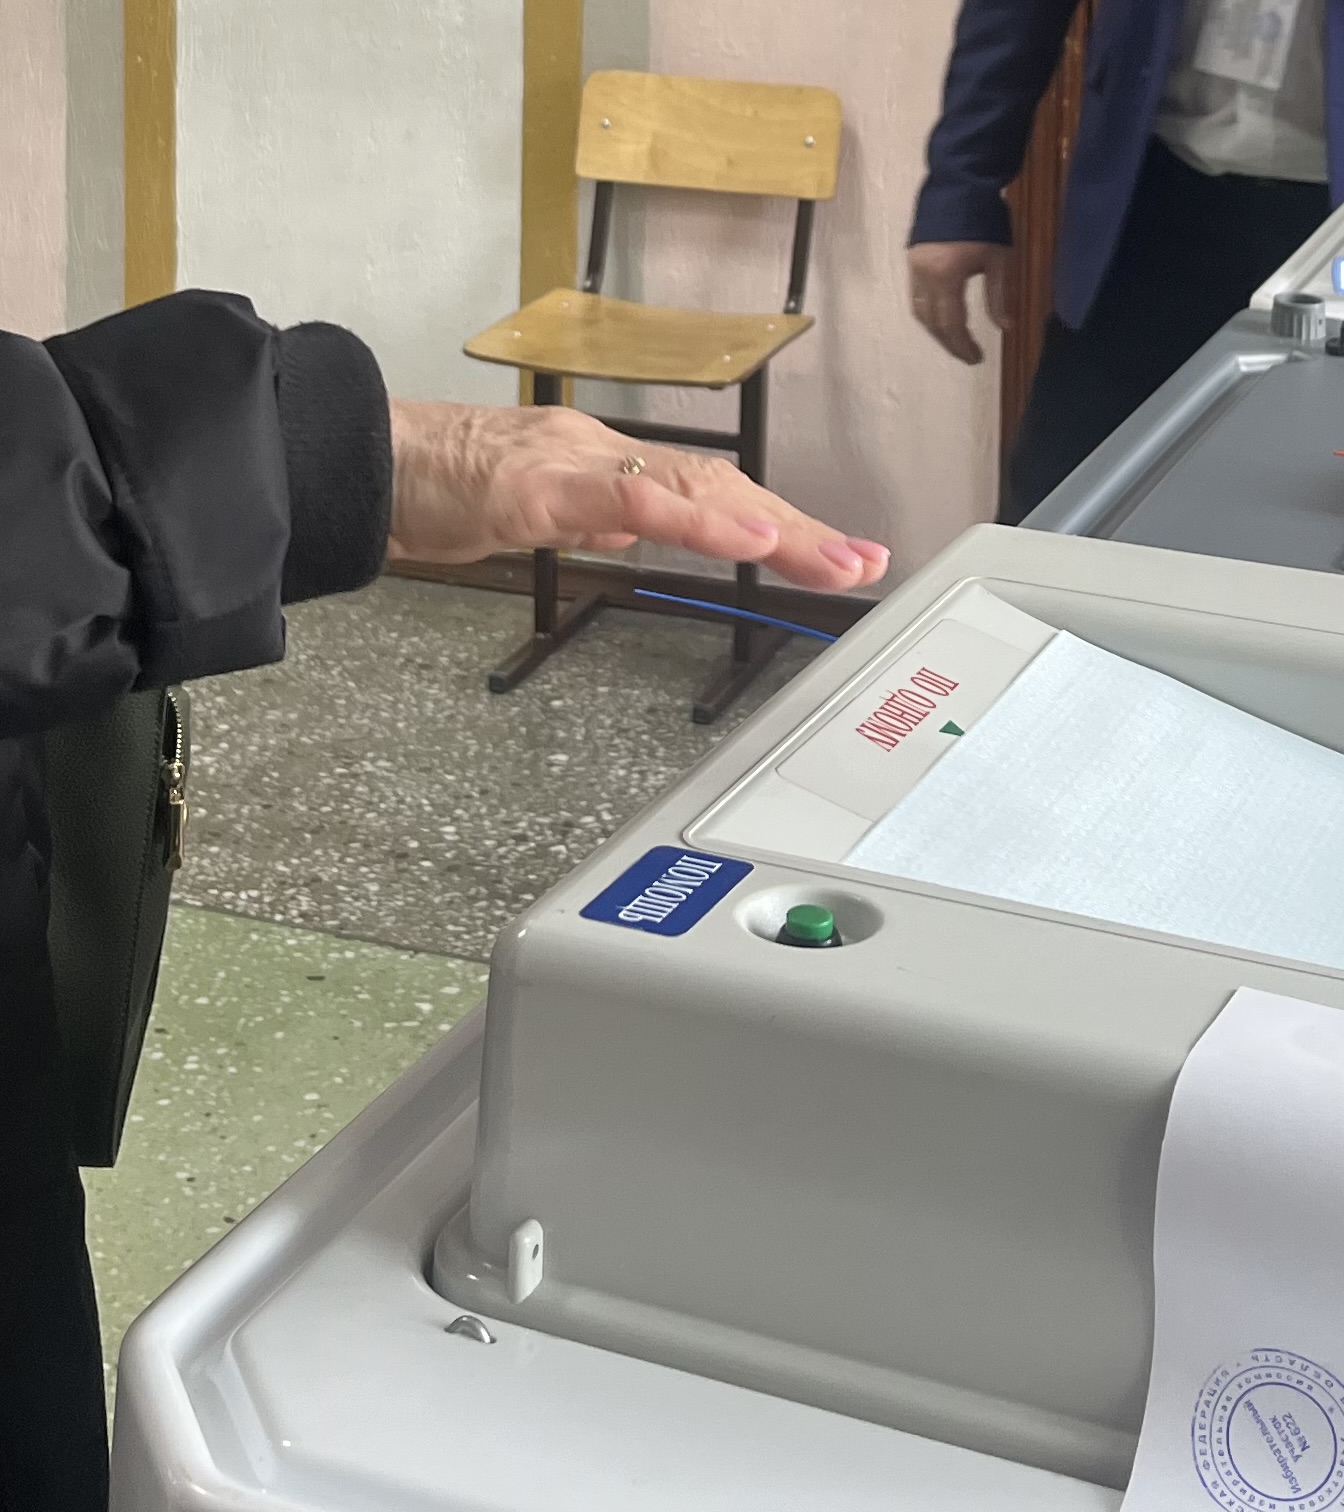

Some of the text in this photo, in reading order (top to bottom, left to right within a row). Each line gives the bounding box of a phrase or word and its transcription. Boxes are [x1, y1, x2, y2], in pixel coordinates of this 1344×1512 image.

[855, 667, 960, 752] ПО ОДНОМУ
[618, 854, 723, 924] ПОМОЩЬ
[1251, 1354, 1334, 1389] ОБЛАСТЬ
[1197, 1369, 1229, 1470] ФЕДЕРАЦИЯ
